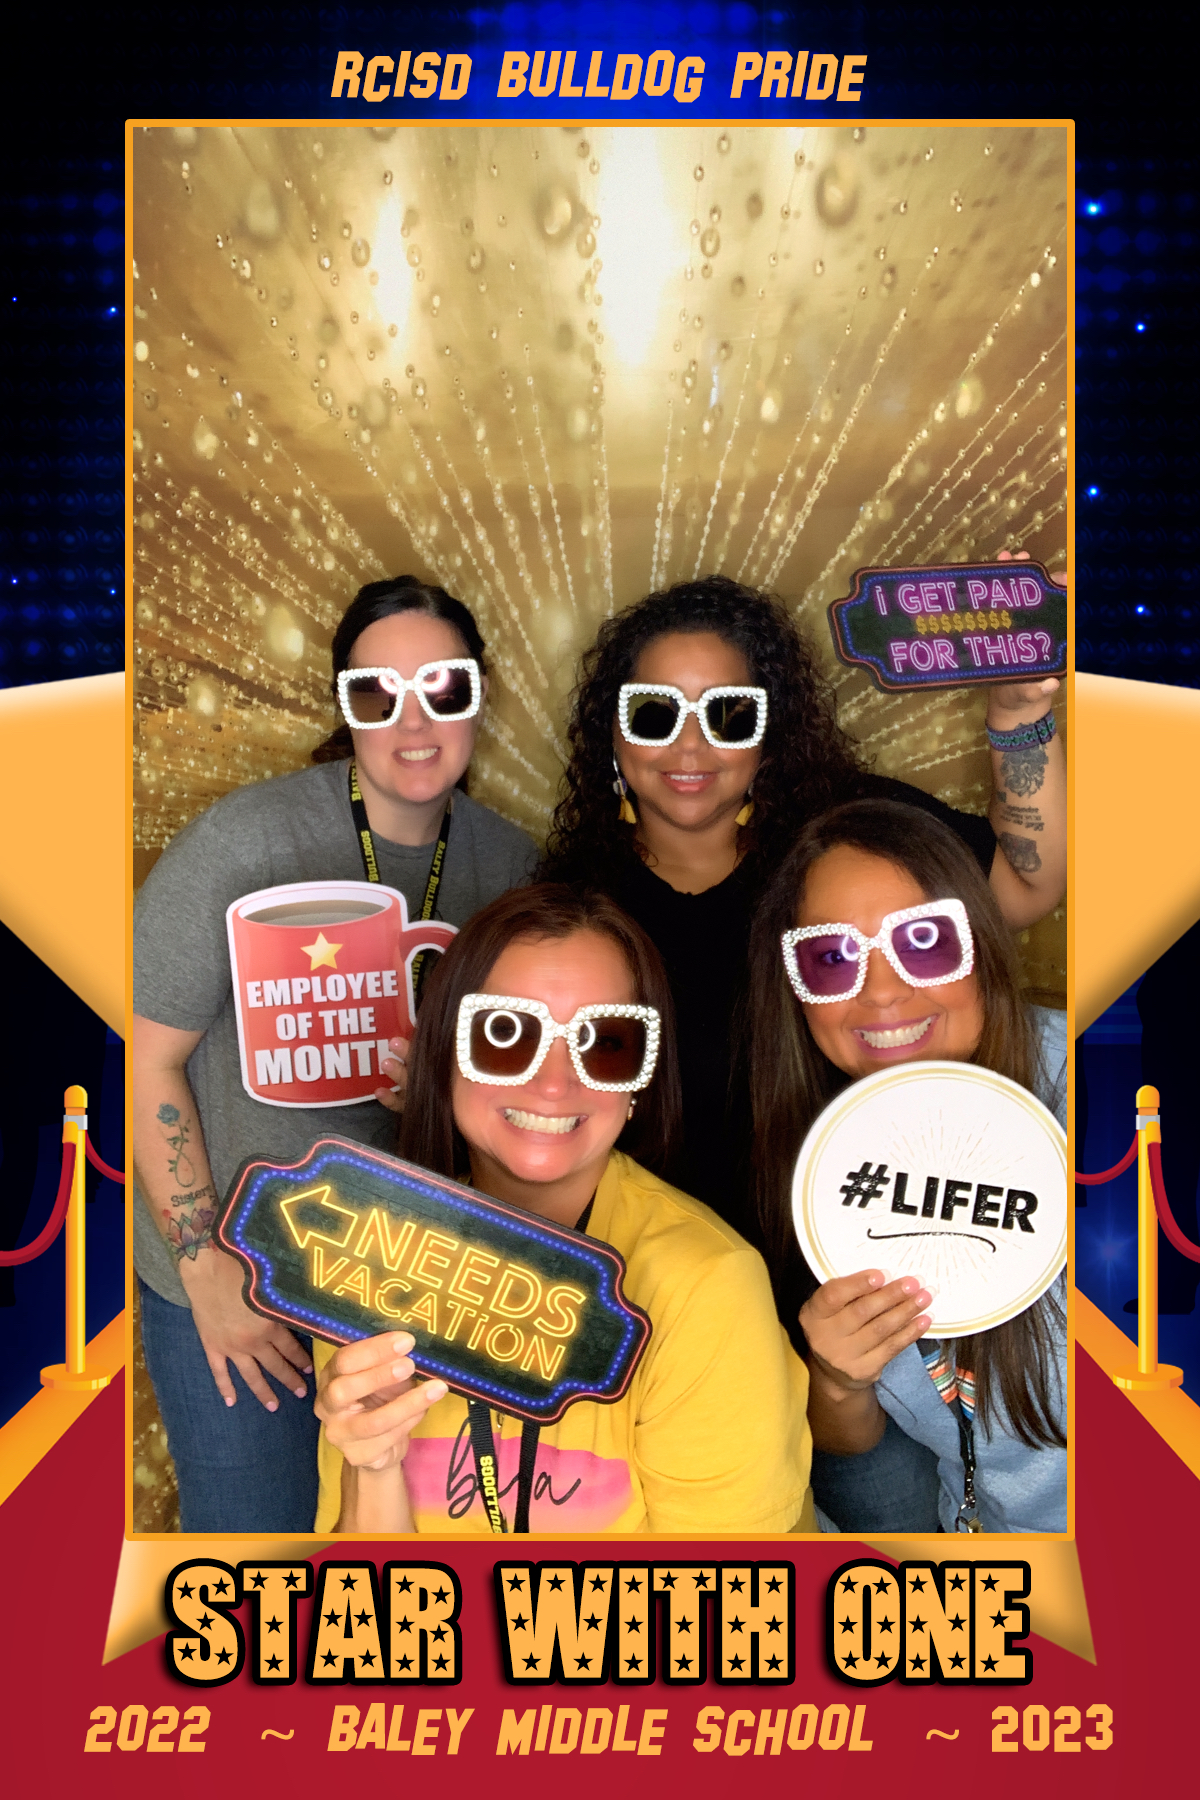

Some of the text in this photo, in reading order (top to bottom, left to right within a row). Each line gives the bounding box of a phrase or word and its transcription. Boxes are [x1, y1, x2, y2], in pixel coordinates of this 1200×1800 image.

[897, 581, 957, 614] GET
[967, 577, 1042, 610] PAID
[890, 631, 1051, 673] FOR THIS?
[361, 830, 379, 882] BULLDOGS
[432, 840, 446, 875] BALEY
[246, 969, 399, 1008] EMPLOYEE
[275, 1006, 377, 1041] OF THE
[839, 1161, 1039, 1234] #LIFER
[353, 1208, 587, 1338] NEEDS
[311, 1246, 567, 1382] VACATION
[480, 1455, 502, 1533] BULLDOGS
